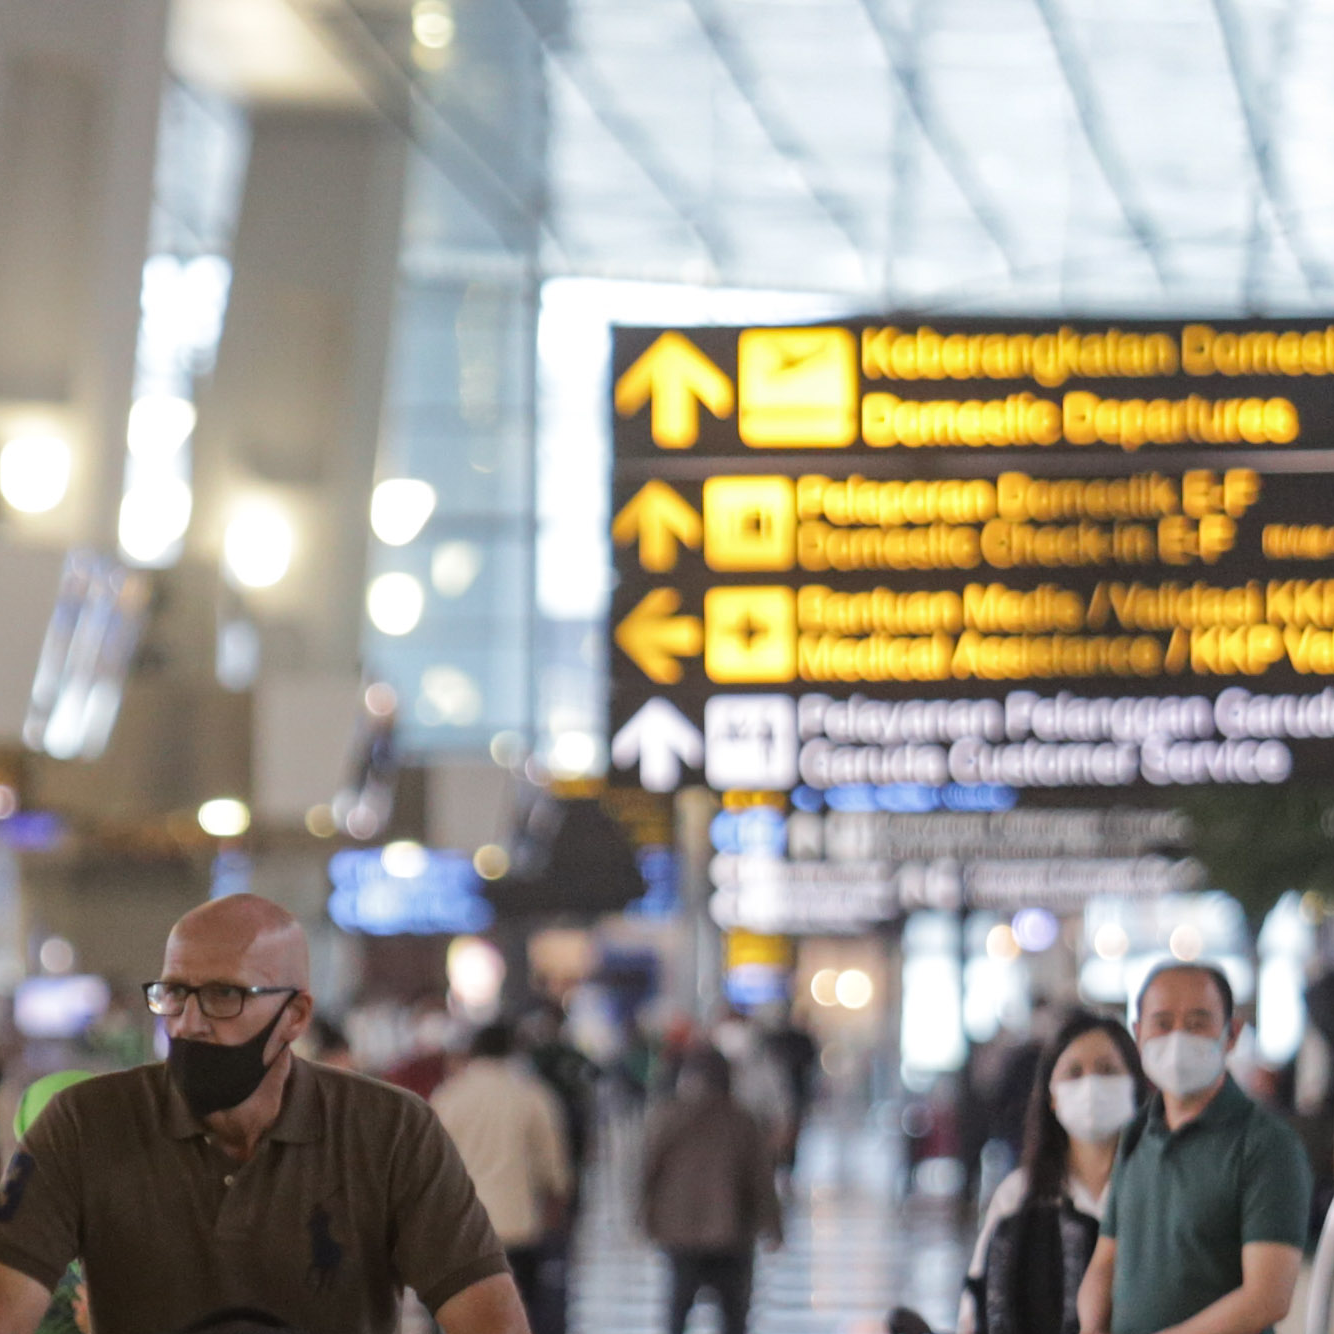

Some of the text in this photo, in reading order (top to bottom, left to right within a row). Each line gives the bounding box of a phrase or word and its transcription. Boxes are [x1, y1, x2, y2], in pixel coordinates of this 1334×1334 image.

[863, 326, 1176, 386] Keberangkatan
[863, 391, 1299, 451] Domestic Departures
[797, 474, 996, 527] Pelaporan
[998, 472, 1179, 520] Domestik
[797, 520, 982, 571] Domestic
[982, 518, 1153, 568] Check-in
[798, 584, 963, 634] Bantuan
[964, 582, 1084, 632] Medis
[1109, 579, 1264, 630] Validasi
[798, 630, 953, 681] Medical
[951, 629, 1163, 679] Assistance
[1190, 623, 1285, 675] KKP
[798, 693, 1005, 745] Pelayanan
[1006, 690, 1213, 744] Pelanggan
[798, 732, 1292, 790] Garuda Customer Service
